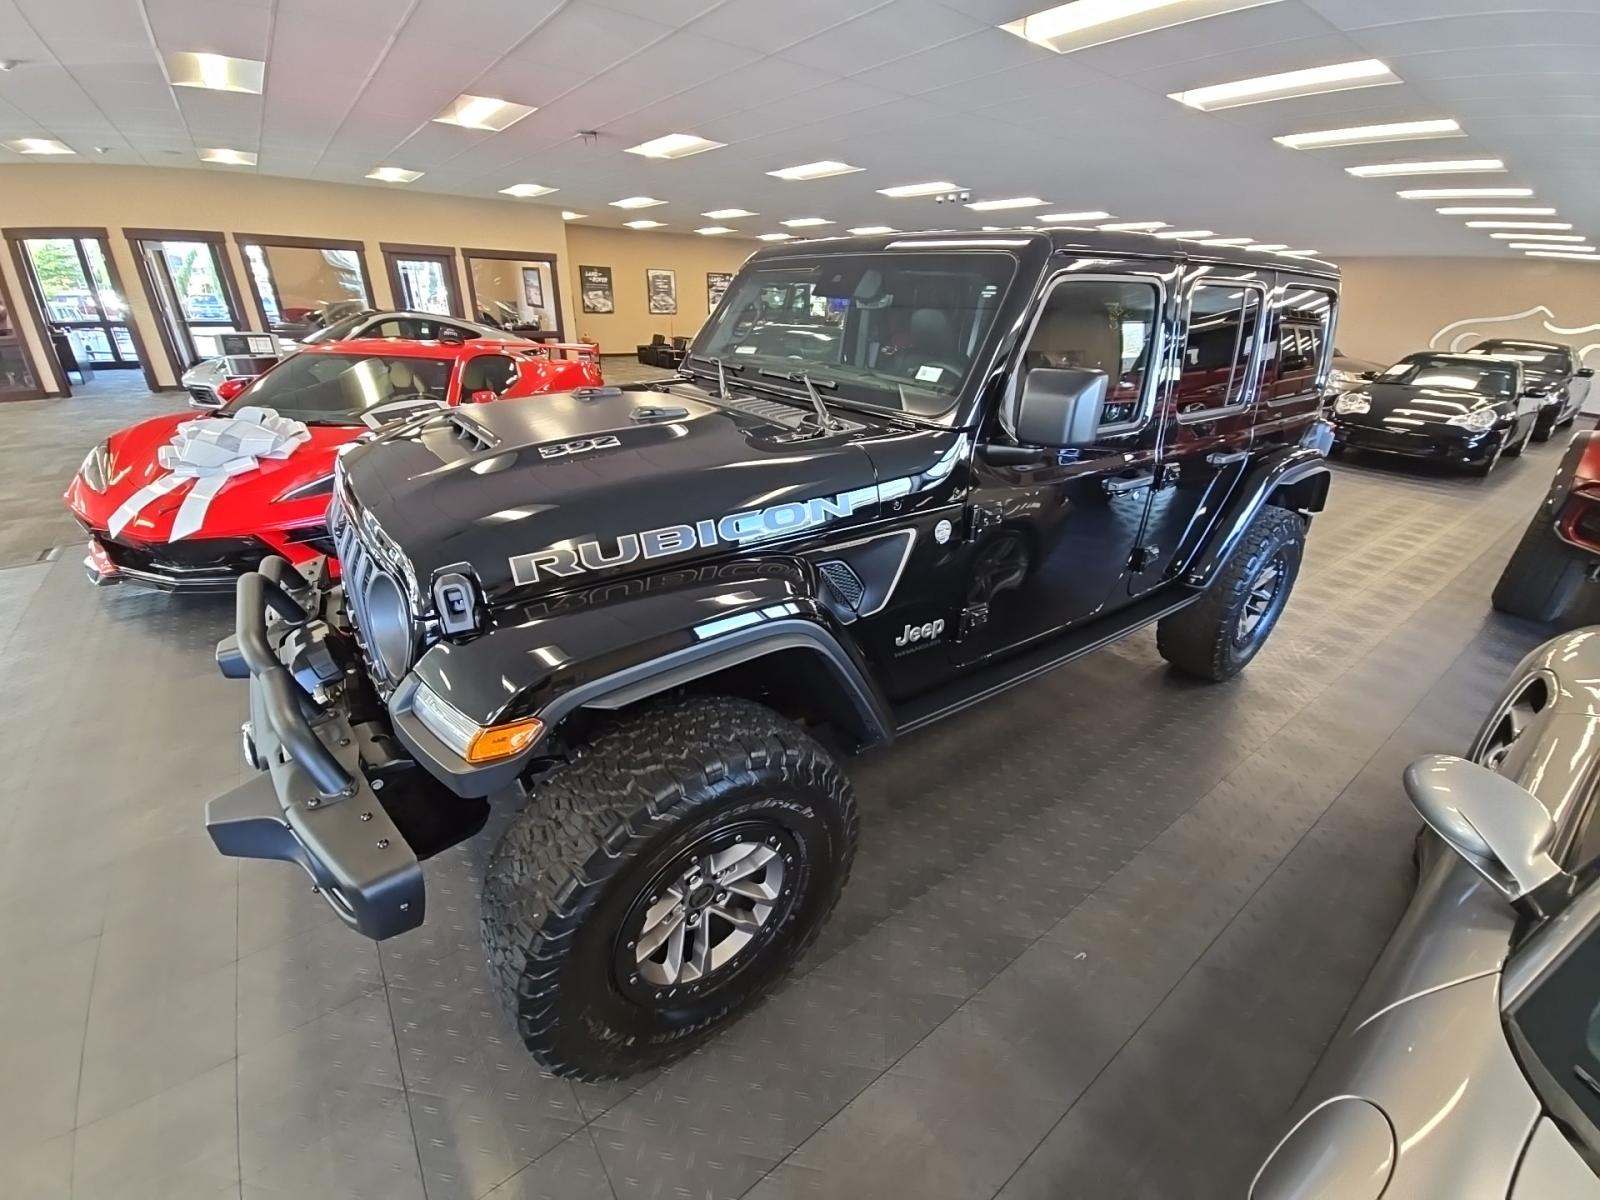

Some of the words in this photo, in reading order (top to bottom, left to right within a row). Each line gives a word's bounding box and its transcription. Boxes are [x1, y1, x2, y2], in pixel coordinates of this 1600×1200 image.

[538, 435, 621, 459] 392
[509, 494, 853, 587] RUBICON
[895, 618, 945, 646] Jeep
